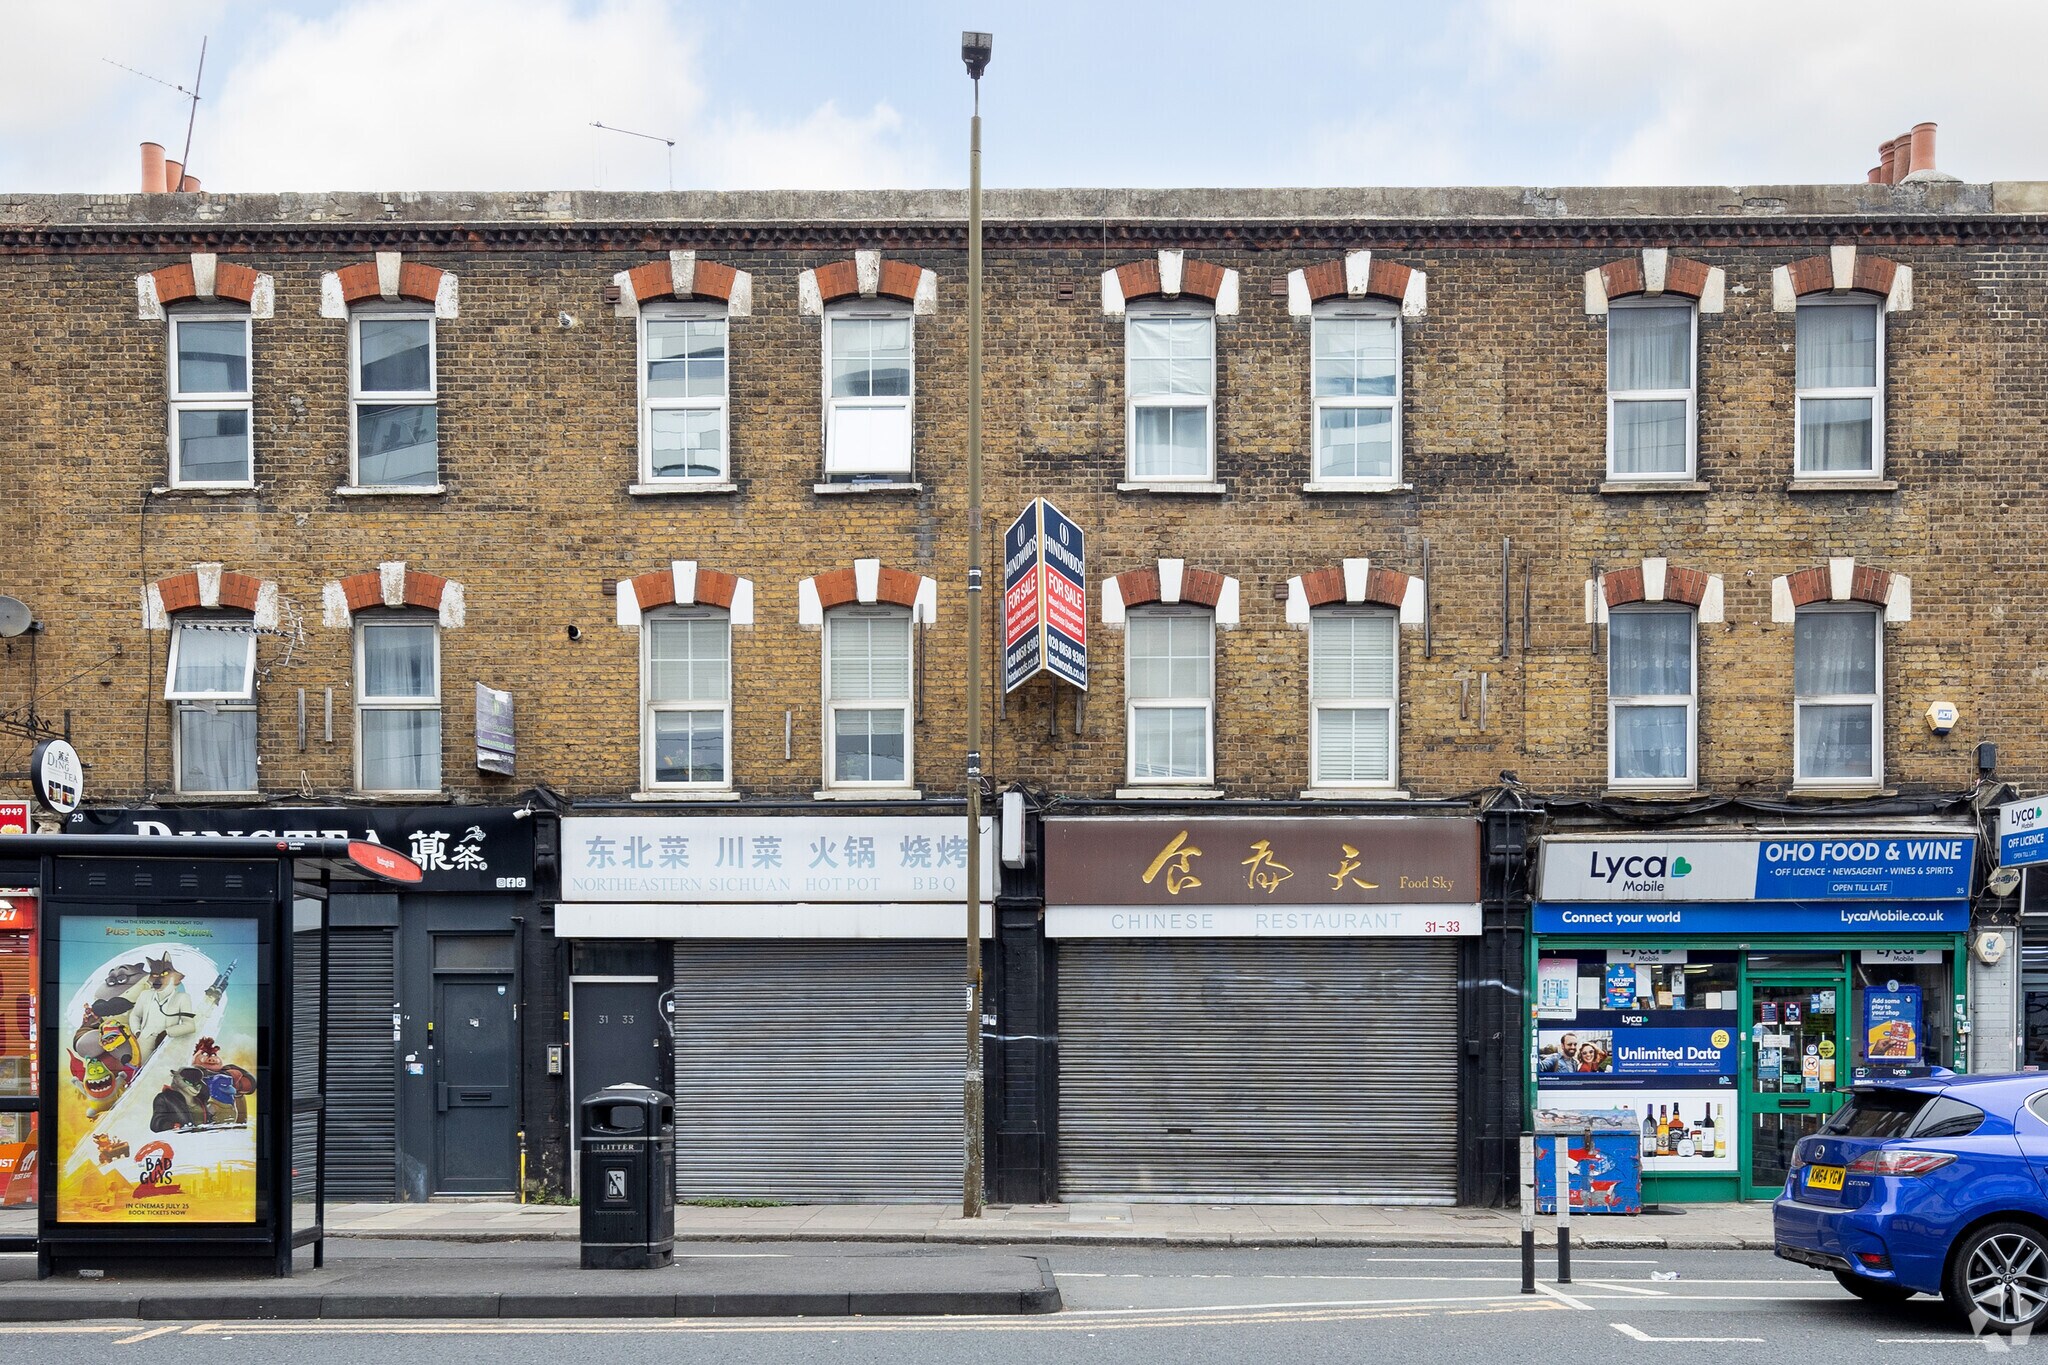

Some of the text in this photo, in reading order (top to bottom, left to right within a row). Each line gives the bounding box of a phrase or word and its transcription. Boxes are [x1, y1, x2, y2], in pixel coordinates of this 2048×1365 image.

[1006, 535, 1037, 578] HINDWOODS
[1045, 534, 1083, 576] HINDWOODS
[1008, 573, 1036, 612] FOR SALE
[1048, 572, 1082, 611] FOR SALE
[1048, 634, 1058, 650] 020
[48, 751, 70, 772] DING
[63, 772, 78, 784] TEA
[0, 808, 23, 816] 4949
[72, 814, 83, 822] 29
[2012, 807, 2034, 826] Lyca
[2008, 834, 2044, 848] OFF LICENCE
[586, 836, 968, 869] 东北菜 川菜 火锅 烧烤
[1766, 842, 1962, 862] OHO FOOD & WINE
[1590, 851, 1667, 883] Lyca
[1775, 868, 1791, 876] OFF
[1793, 868, 1825, 876] LICENCE
[1832, 867, 1883, 875] NEWSAGENT
[572, 878, 701, 891] NORTHEASTERN
[709, 878, 790, 891] SICHUAN
[806, 877, 842, 890] HOT
[847, 877, 880, 890] POT
[1400, 876, 1454, 891] Food Sky
[1622, 880, 1664, 891] Mobile
[1832, 884, 1853, 892] OPEN
[1112, 913, 1402, 929] CHINESE RESTAURANT
[1562, 912, 1680, 925] Connect your world
[1841, 910, 1944, 924] LycaMobile.co.uk
[1425, 921, 1460, 933] 31-33
[599, 1016, 634, 1024] 31 33
[1622, 1015, 1642, 1024] Lyca
[1618, 1047, 1720, 1060] Unlimited Data
[145, 1158, 172, 1172] BAD
[140, 1171, 173, 1185] GUYS
[1829, 1170, 1843, 1185] YGW
